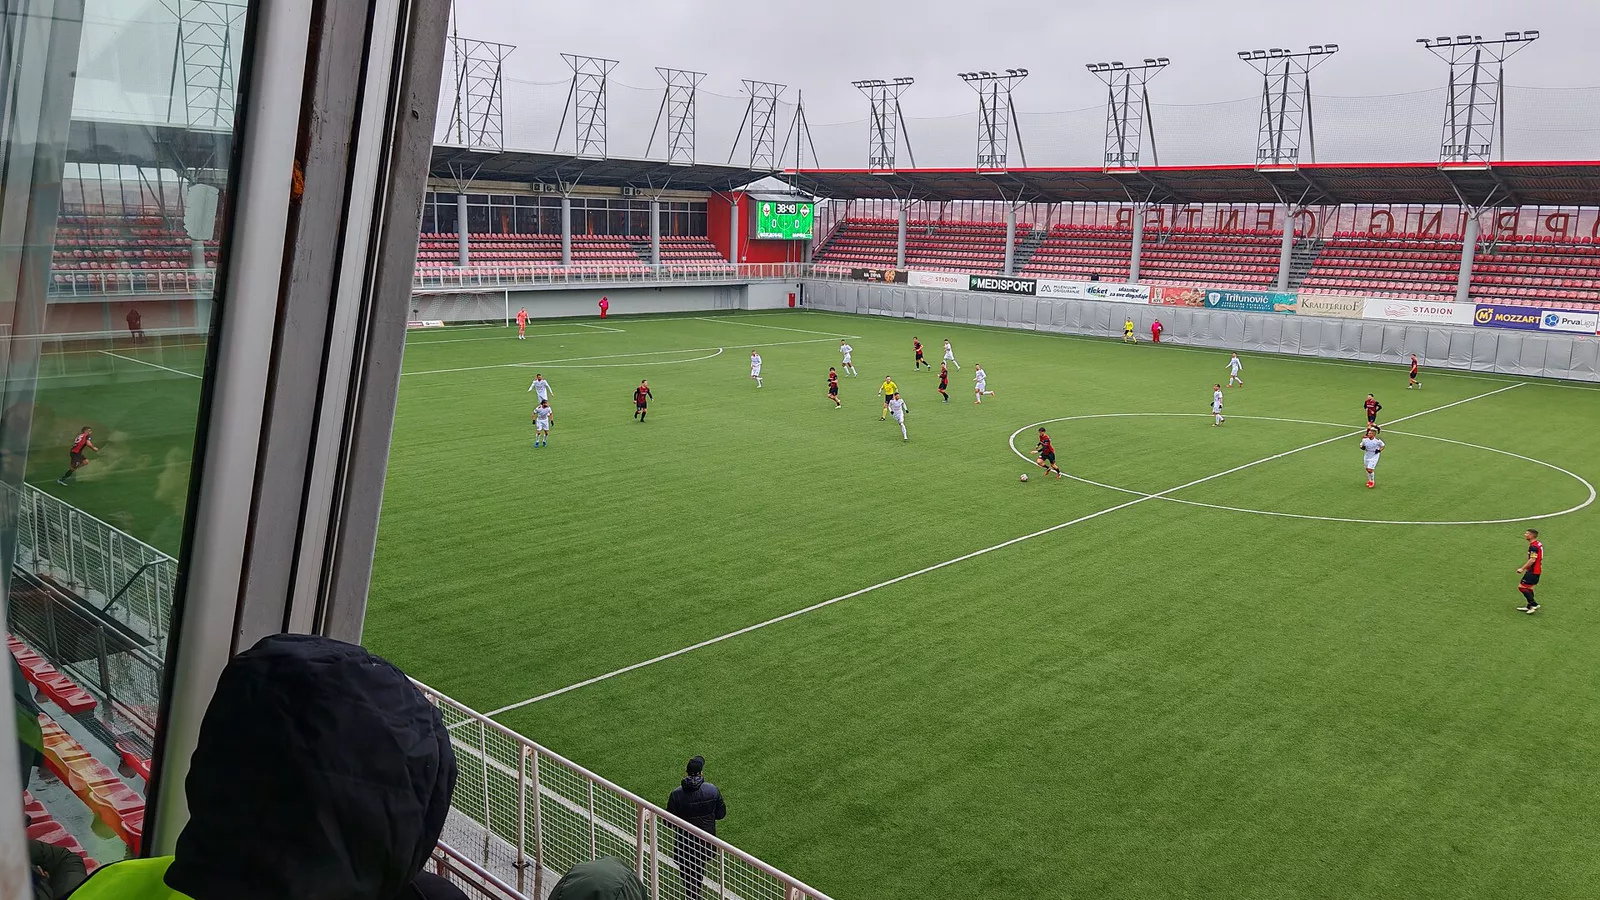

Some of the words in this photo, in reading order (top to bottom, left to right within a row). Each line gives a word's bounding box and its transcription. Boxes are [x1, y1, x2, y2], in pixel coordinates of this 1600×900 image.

[772, 219, 777, 229] 0
[794, 219, 800, 229] 0
[977, 278, 1035, 293] MEDISPORT
[1087, 285, 1108, 295] ticket
[1224, 293, 1269, 304] Trifunović
[1413, 306, 1453, 315] STADION
[1494, 313, 1541, 324] MOZZART
[1561, 317, 1596, 328] PrvaLiga
